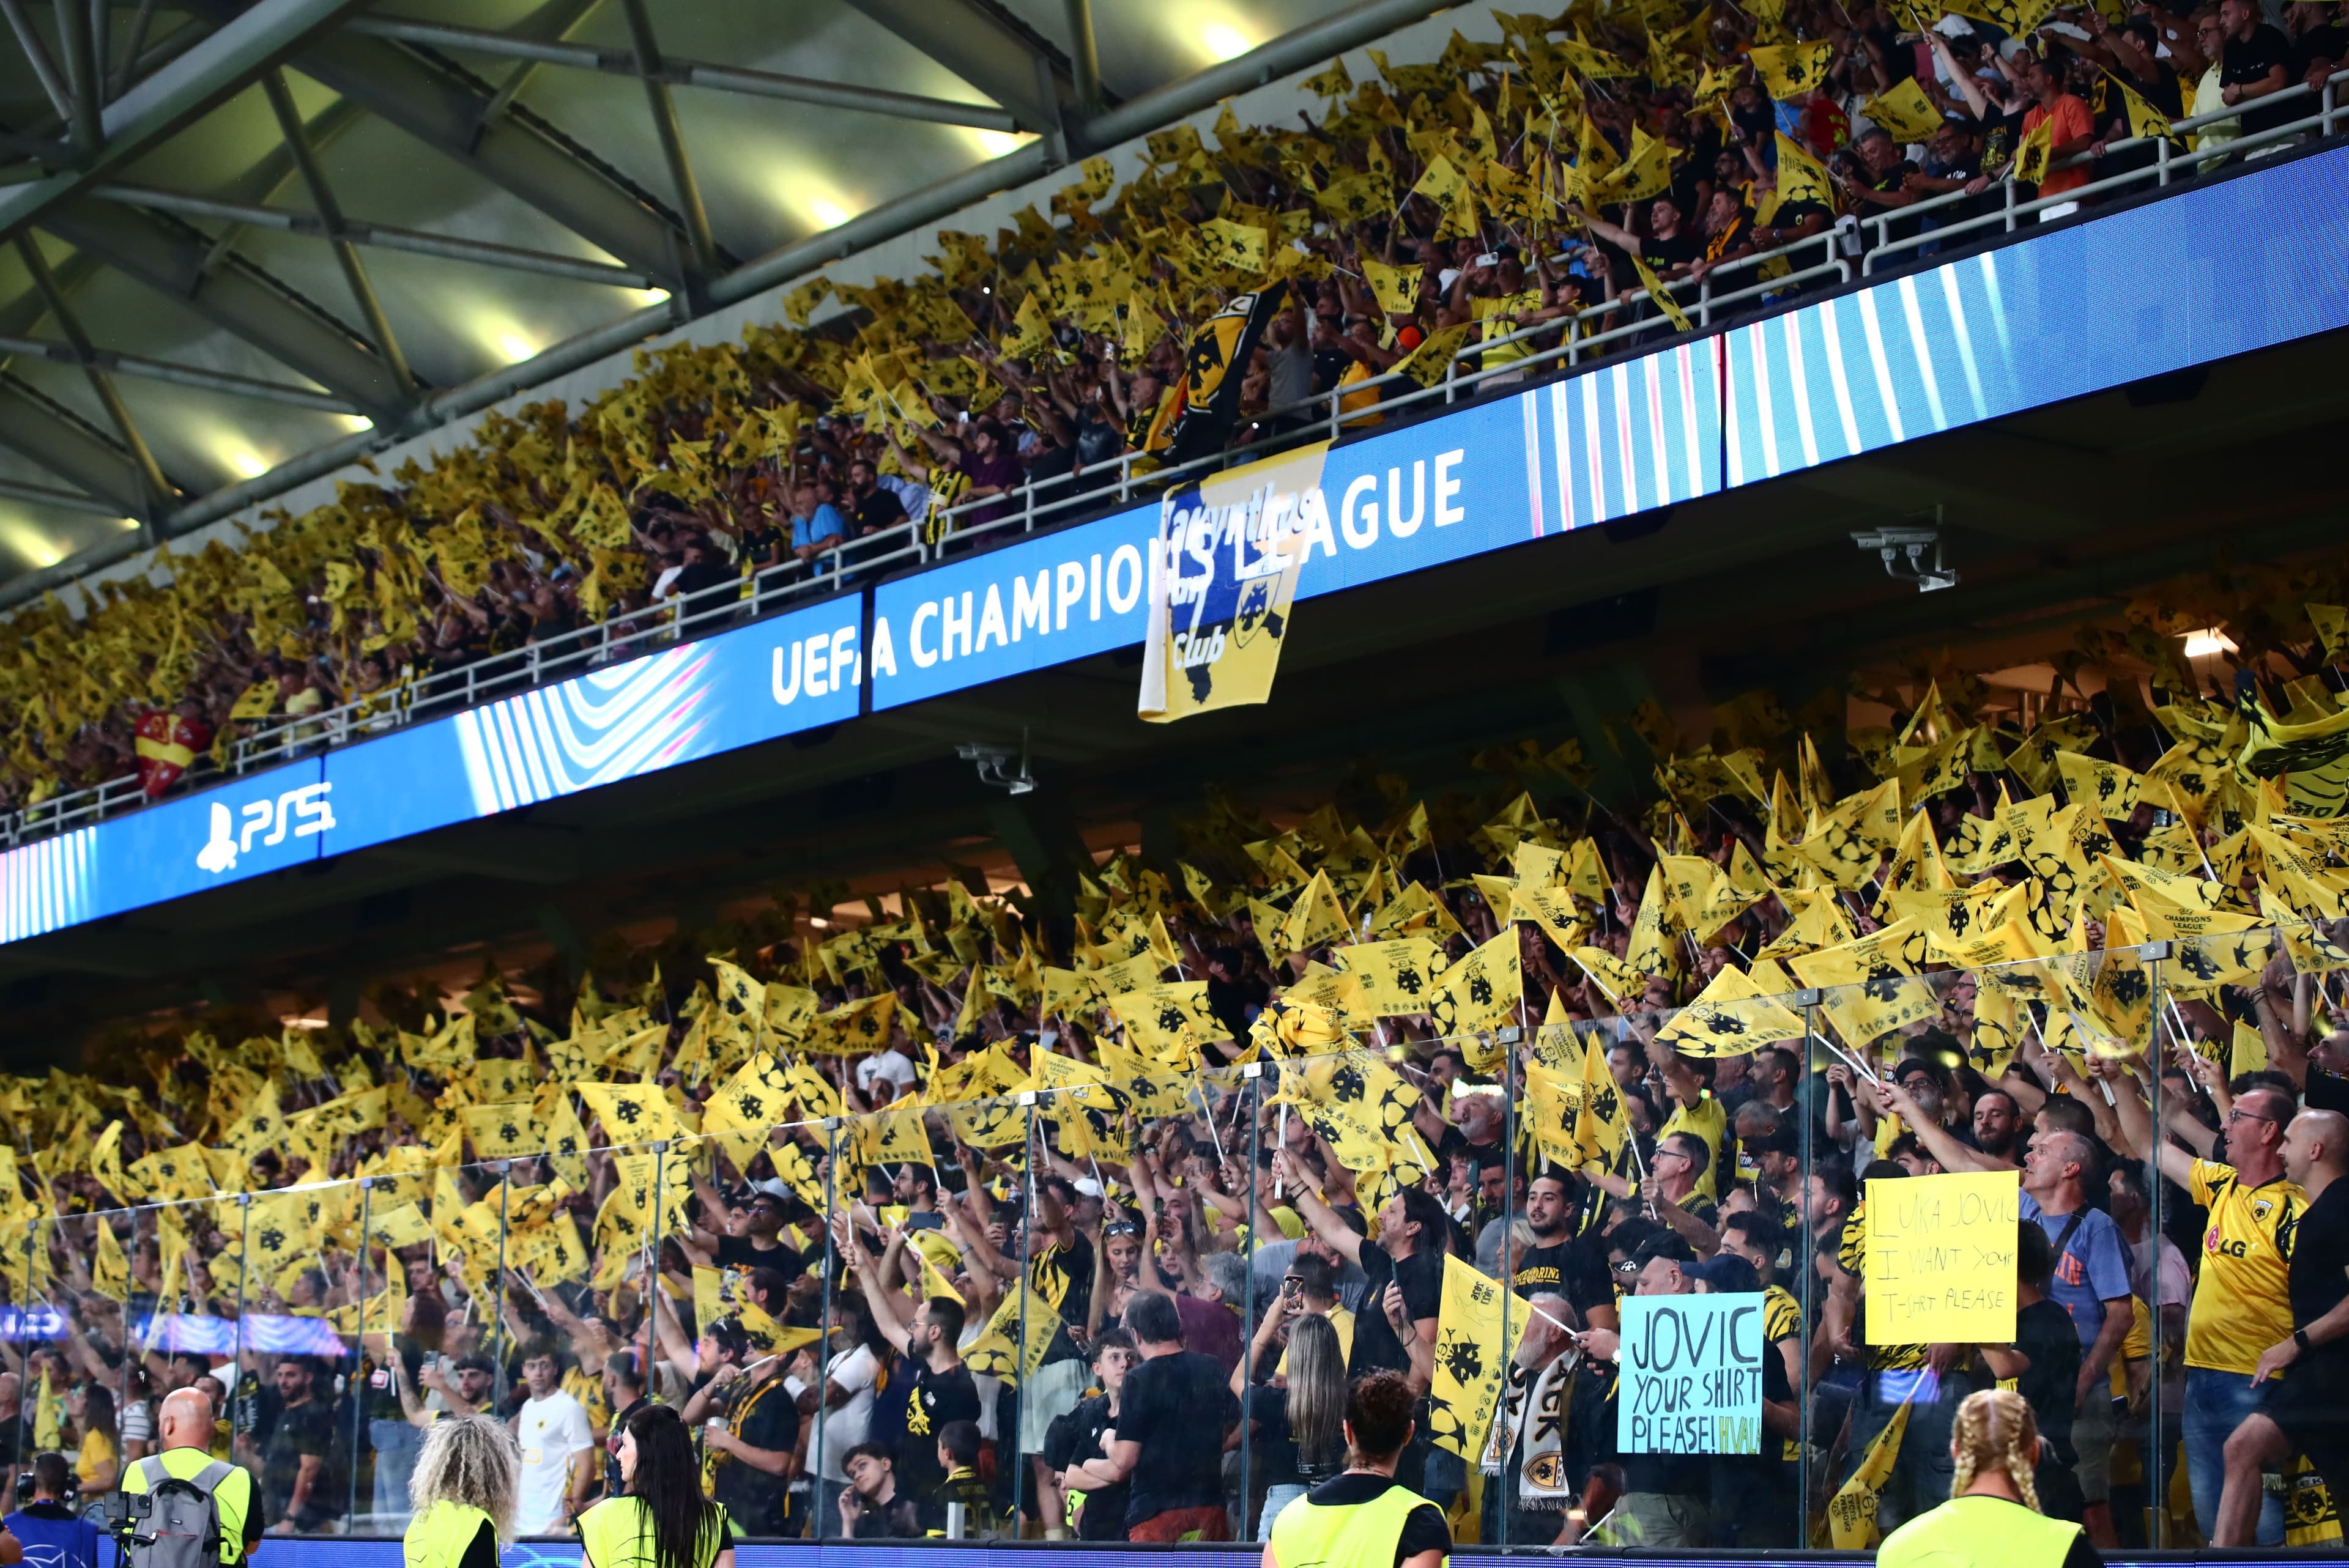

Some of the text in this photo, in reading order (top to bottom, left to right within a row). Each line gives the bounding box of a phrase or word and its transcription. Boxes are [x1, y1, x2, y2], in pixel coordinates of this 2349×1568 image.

[771, 615, 897, 705] UEFA
[1171, 625, 1225, 671] Club
[240, 782, 336, 852] PS5
[1554, 1033, 1569, 1059] LEAGUE
[1556, 1024, 1576, 1063] CHAMPIONS
[1871, 1184, 2017, 1238] LUKA JOVIC
[1876, 1250, 1899, 1280] I
[1908, 1246, 1963, 1274] WANT
[2220, 1239, 2247, 1259] LG
[1945, 1287, 2004, 1310] PLEASE
[1632, 1306, 1759, 1373] JOVIC
[1633, 1367, 1762, 1415] YOUR SHIRT
[1631, 1415, 1715, 1454] PLEASE!
